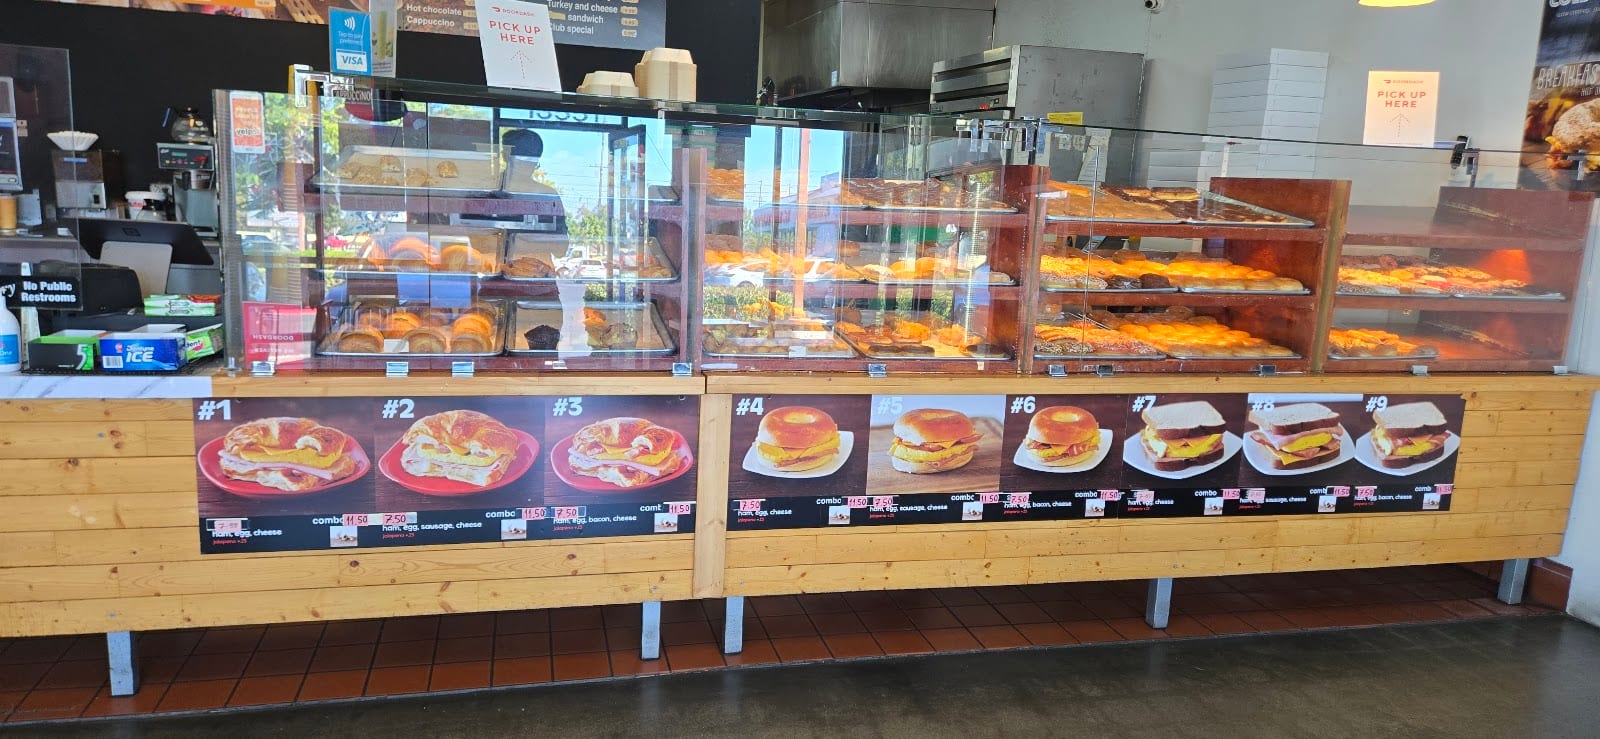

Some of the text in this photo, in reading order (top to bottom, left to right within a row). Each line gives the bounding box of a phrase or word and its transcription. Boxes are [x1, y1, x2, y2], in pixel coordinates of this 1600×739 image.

[406, 4, 422, 12] Hot
[423, 5, 462, 15] chocolate
[548, 0, 573, 11] Turkey
[575, 3, 589, 11] and
[591, 4, 618, 13] cheese
[407, 16, 455, 27] Cappuccino
[567, 14, 604, 24] sandwich
[489, 21, 520, 33] PICK
[524, 23, 541, 34] UP
[567, 25, 594, 35] special
[500, 33, 535, 45] HERE
[341, 56, 363, 64] VISA
[1537, 63, 1600, 90] BREAKFAS
[1385, 100, 1417, 108] HERE
[23, 281, 38, 291] No
[40, 281, 72, 291] Public
[21, 292, 77, 303] Restrooms
[76, 344, 88, 370] 5
[126, 351, 154, 363] ICE
[382, 398, 414, 419] #2
[552, 397, 583, 417] #3
[736, 397, 764, 415] #4
[877, 397, 903, 414] #5
[1011, 396, 1036, 414] #6
[1132, 395, 1156, 412] #7
[1251, 397, 1275, 412] #8
[1366, 396, 1388, 412] #9
[198, 399, 232, 421] #1
[1100, 490, 1118, 500] 11.50
[1223, 489, 1240, 498] 11.50
[1334, 487, 1350, 496] 11.50
[1360, 487, 1374, 497] 7.50
[816, 497, 842, 505] combo
[849, 498, 867, 507] 11.50
[875, 497, 893, 506] 7.50
[981, 494, 999, 503] 11.50
[1011, 495, 1027, 503] 7.50
[640, 504, 661, 512] com
[669, 504, 690, 514] 11.50
[742, 501, 760, 510] 7.50
[900, 504, 926, 512] sausage,
[927, 503, 948, 511] cheese
[1033, 500, 1051, 508] bacon,
[524, 508, 545, 519] 11.50
[556, 508, 577, 517] 7.50
[346, 517, 368, 525] 11.50
[384, 513, 406, 524] 7.50
[612, 514, 637, 522] cheese
[382, 521, 482, 533] ham, egg, sausage, cheese
[253, 528, 282, 537] cheese
